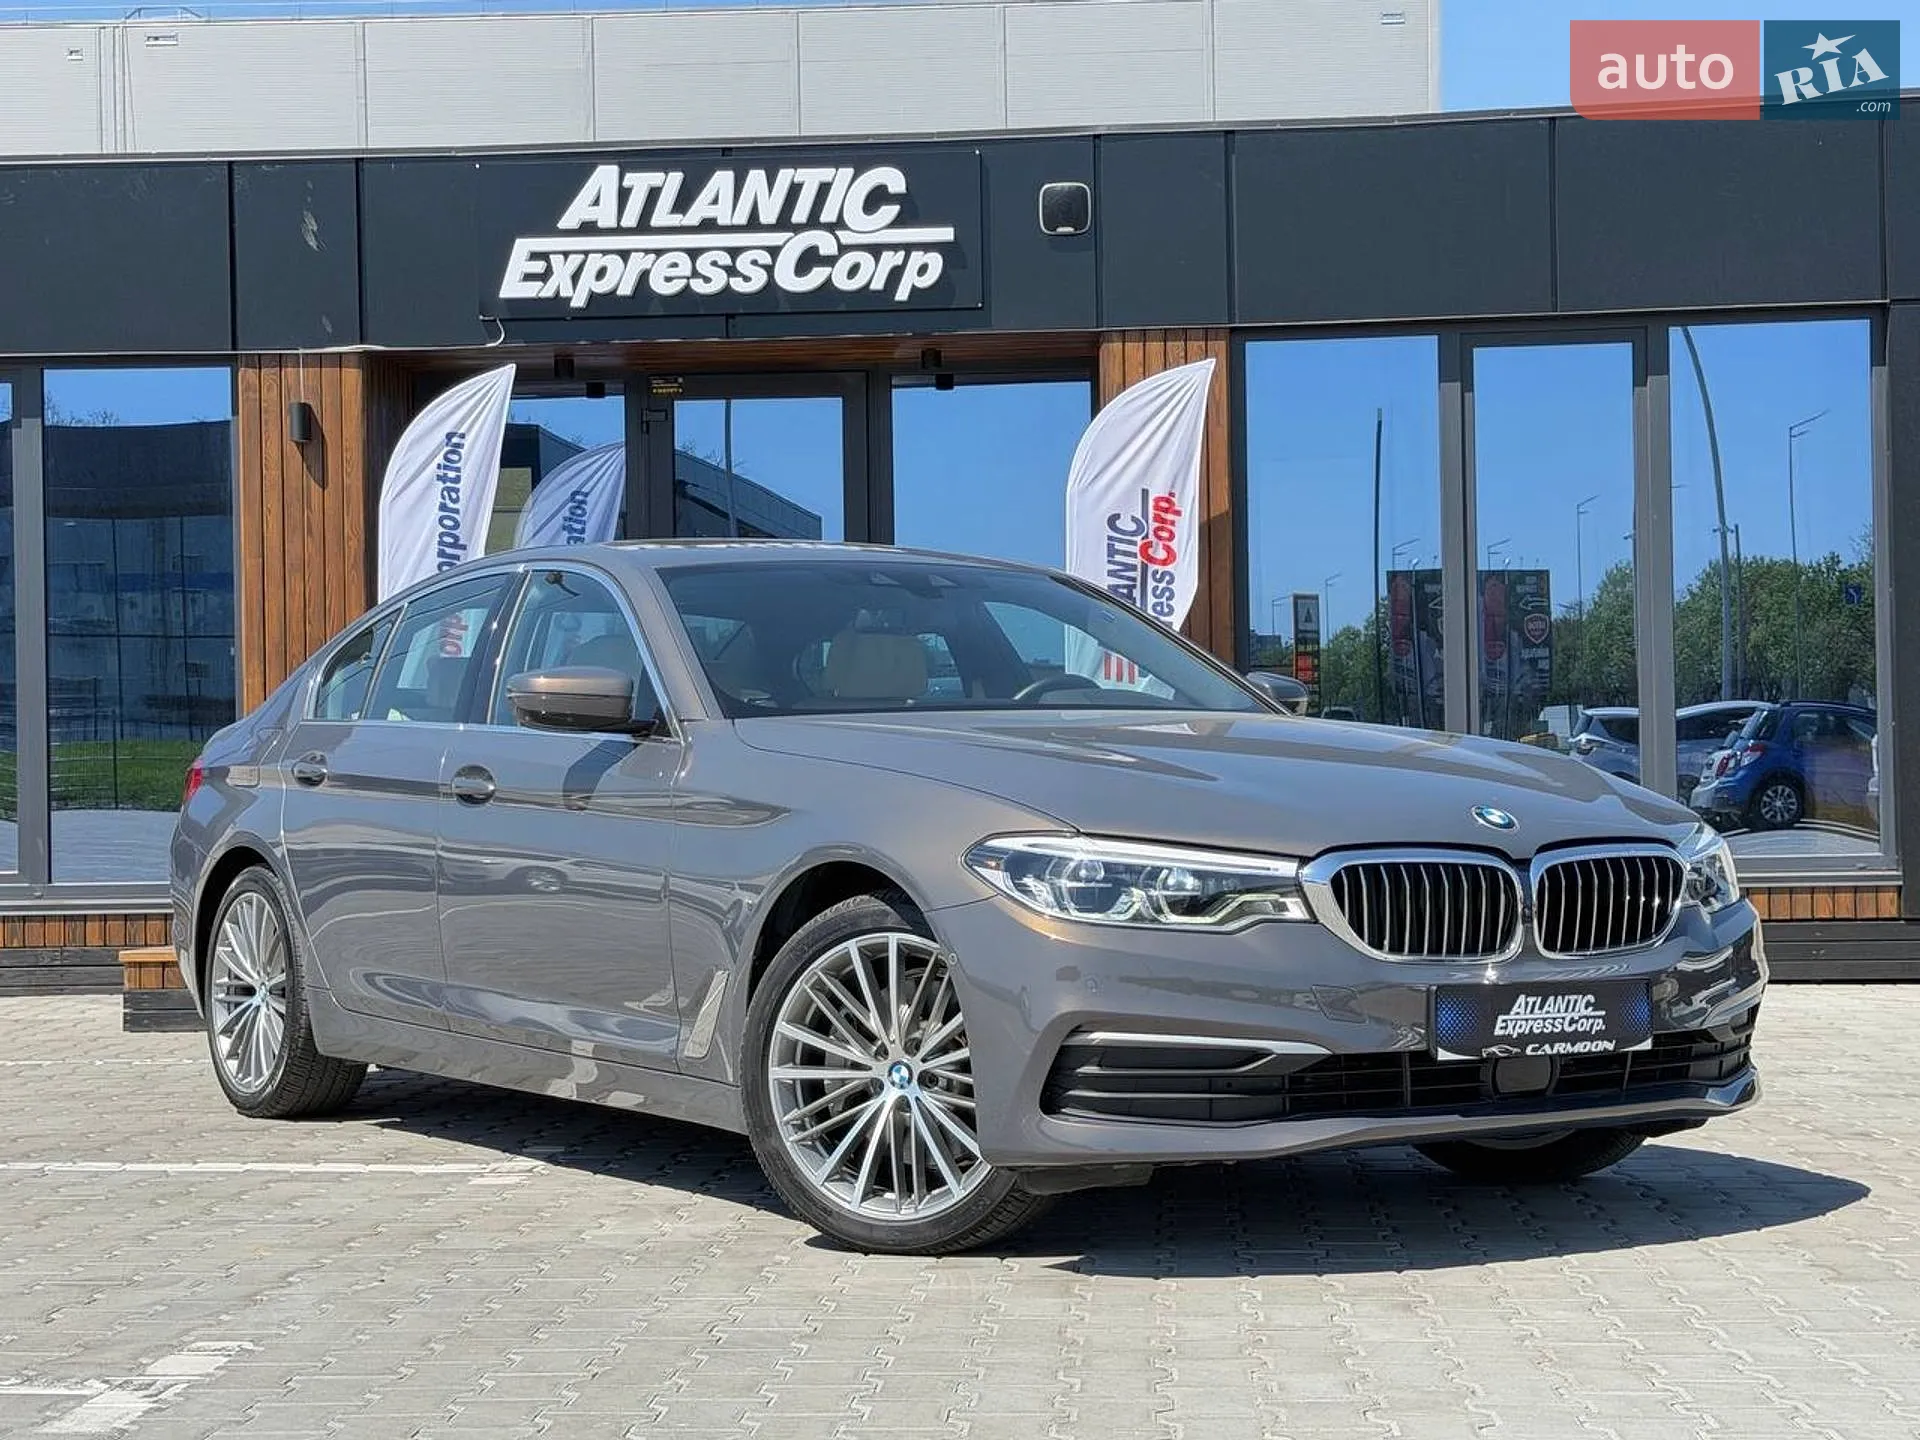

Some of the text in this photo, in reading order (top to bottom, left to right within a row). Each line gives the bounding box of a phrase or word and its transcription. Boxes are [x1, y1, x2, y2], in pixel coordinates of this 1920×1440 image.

[557, 164, 907, 232] ATLANTIC
[499, 230, 943, 308] ExpressCorp
[1510, 994, 1596, 1015] ATLANTIC
[1526, 1040, 1616, 1056] CARMOON
